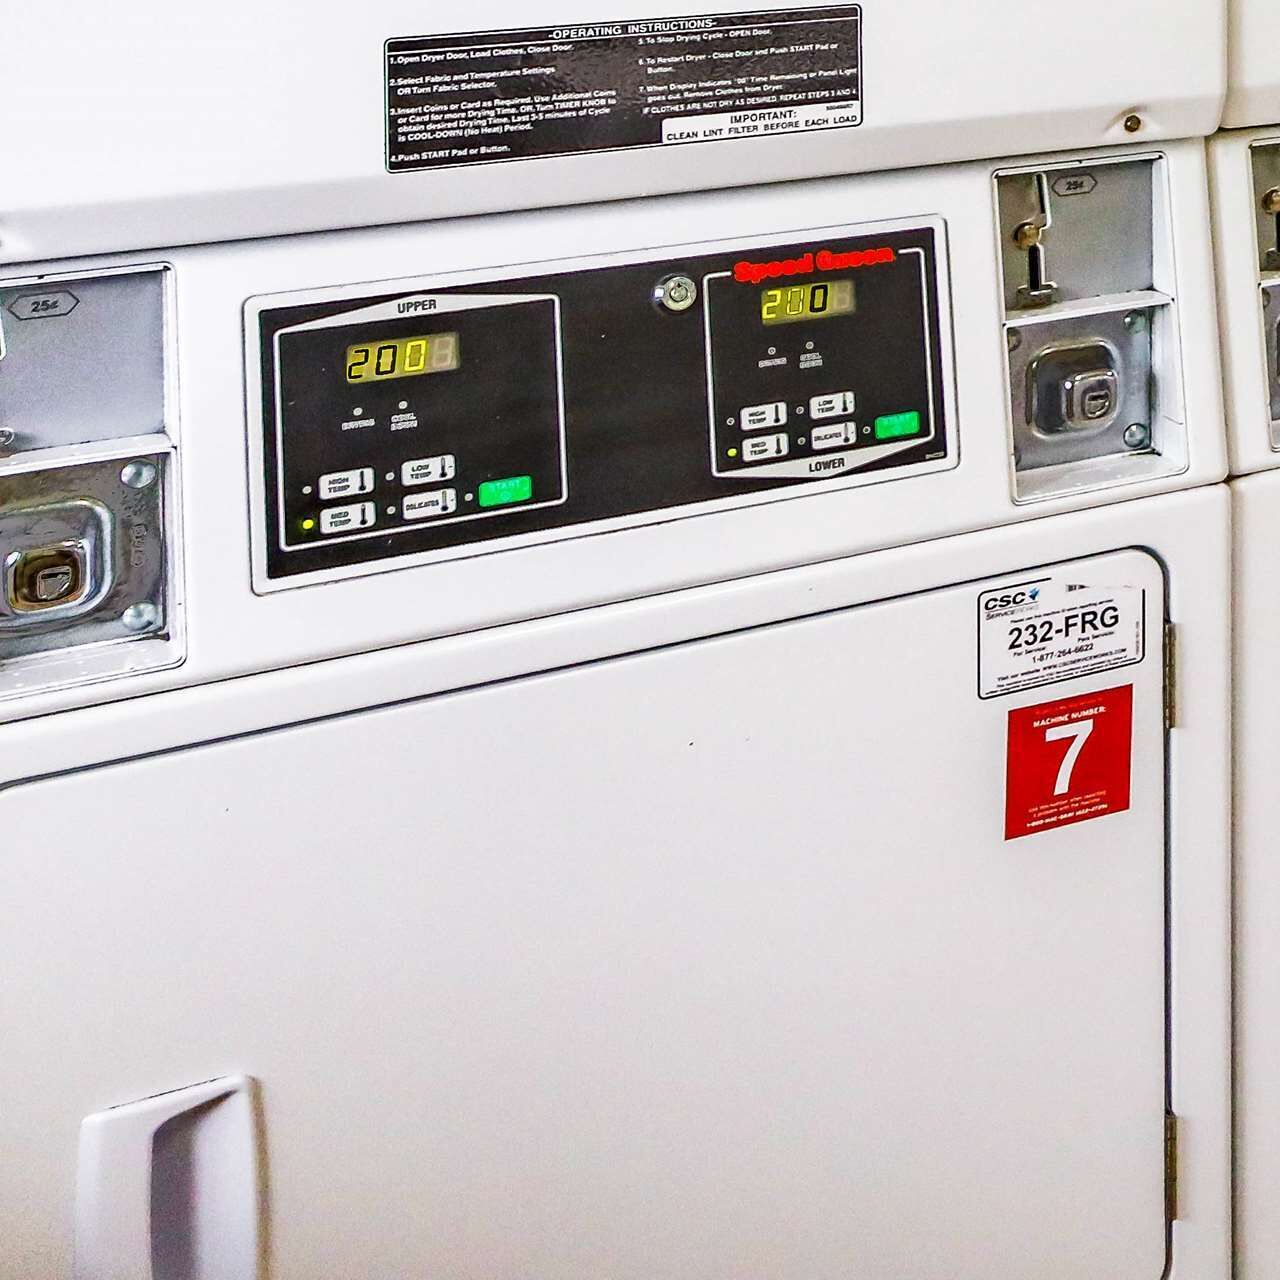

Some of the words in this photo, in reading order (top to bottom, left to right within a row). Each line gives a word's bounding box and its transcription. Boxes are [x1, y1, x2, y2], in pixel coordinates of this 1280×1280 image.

[421, 54, 445, 63] Dryer
[470, 50, 491, 58] Load
[527, 46, 551, 54] Close
[789, 44, 814, 52] START
[425, 74, 451, 83] Fabric
[453, 73, 468, 81] and
[469, 69, 521, 81] Temperature
[397, 87, 412, 96] OR
[412, 86, 431, 94] Turn
[433, 83, 459, 92] Fabric
[408, 115, 430, 123] Card
[430, 113, 443, 121] for
[467, 109, 495, 119] Drying
[582, 98, 606, 106] KNOB
[423, 104, 449, 113] Coins
[460, 100, 480, 109] Card
[534, 95, 551, 103] Use
[651, 104, 685, 113] CLOTHES
[397, 125, 425, 133] obtain
[426, 121, 458, 130] desired
[459, 118, 487, 128] Drying
[511, 114, 530, 122] Last
[531, 112, 544, 120] 3-5
[545, 110, 577, 119] minutes
[588, 107, 611, 116] Cycle
[730, 110, 797, 124] IMPORTANT:
[398, 134, 406, 142] is
[407, 130, 463, 142] COOL-DOWN
[666, 130, 699, 141] CLEAN
[703, 128, 724, 137] LINT
[728, 125, 759, 135] FILTER
[763, 121, 800, 131] BEFORE
[805, 118, 829, 127] EACH
[833, 115, 857, 124] LOAD
[421, 150, 450, 159] START
[451, 148, 468, 157] Pad
[30, 298, 59, 314] 25¢
[397, 298, 437, 313] UPPER
[762, 283, 828, 319] 200
[347, 339, 427, 380] 200
[411, 463, 430, 473] LOW
[808, 458, 846, 473] LOWER
[984, 592, 1026, 612] CSC
[1008, 606, 1119, 651] 232-FRG
[1033, 713, 1069, 728] MACHINE
[1071, 705, 1106, 720] NUMBER:
[1045, 718, 1094, 797] 7
